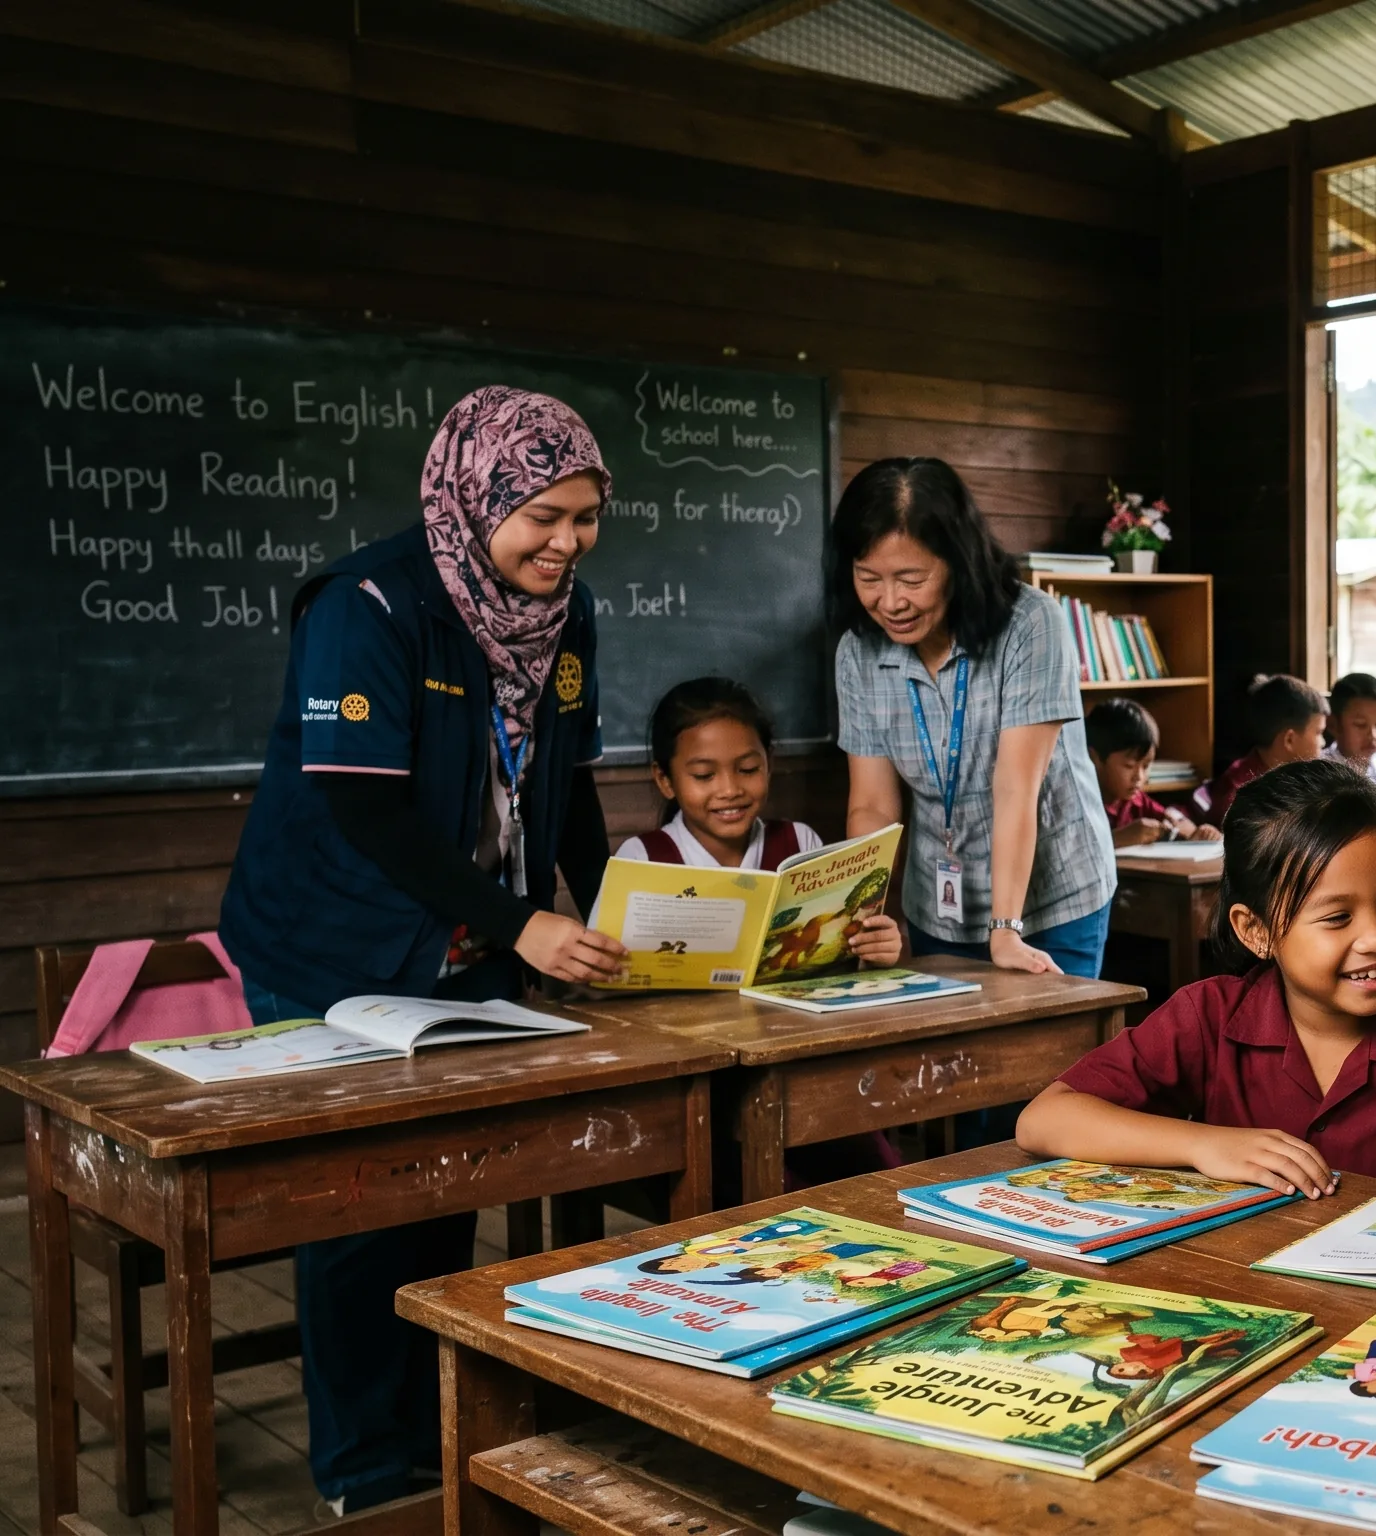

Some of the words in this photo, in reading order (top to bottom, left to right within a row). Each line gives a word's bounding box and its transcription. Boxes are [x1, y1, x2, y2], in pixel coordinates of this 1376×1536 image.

[32, 362, 205, 418] Welcome
[231, 377, 269, 421] to
[292, 381, 436, 445] English!
[656, 381, 757, 418] Welcome
[772, 391, 796, 420] to
[661, 423, 719, 448] school
[44, 446, 168, 514] Happy
[201, 451, 357, 520] Reading!
[673, 488, 709, 521] for
[49, 518, 153, 574] Happy
[168, 525, 243, 559] thall
[256, 529, 326, 578] days
[80, 579, 179, 623] Good
[202, 585, 280, 635] Job!
[307, 697, 339, 713] Rotary
[789, 868, 821, 885] The
[870, 1380, 1005, 1418] Jungle
[893, 1361, 1107, 1414] Adventure
[1005, 1407, 1057, 1428] The
